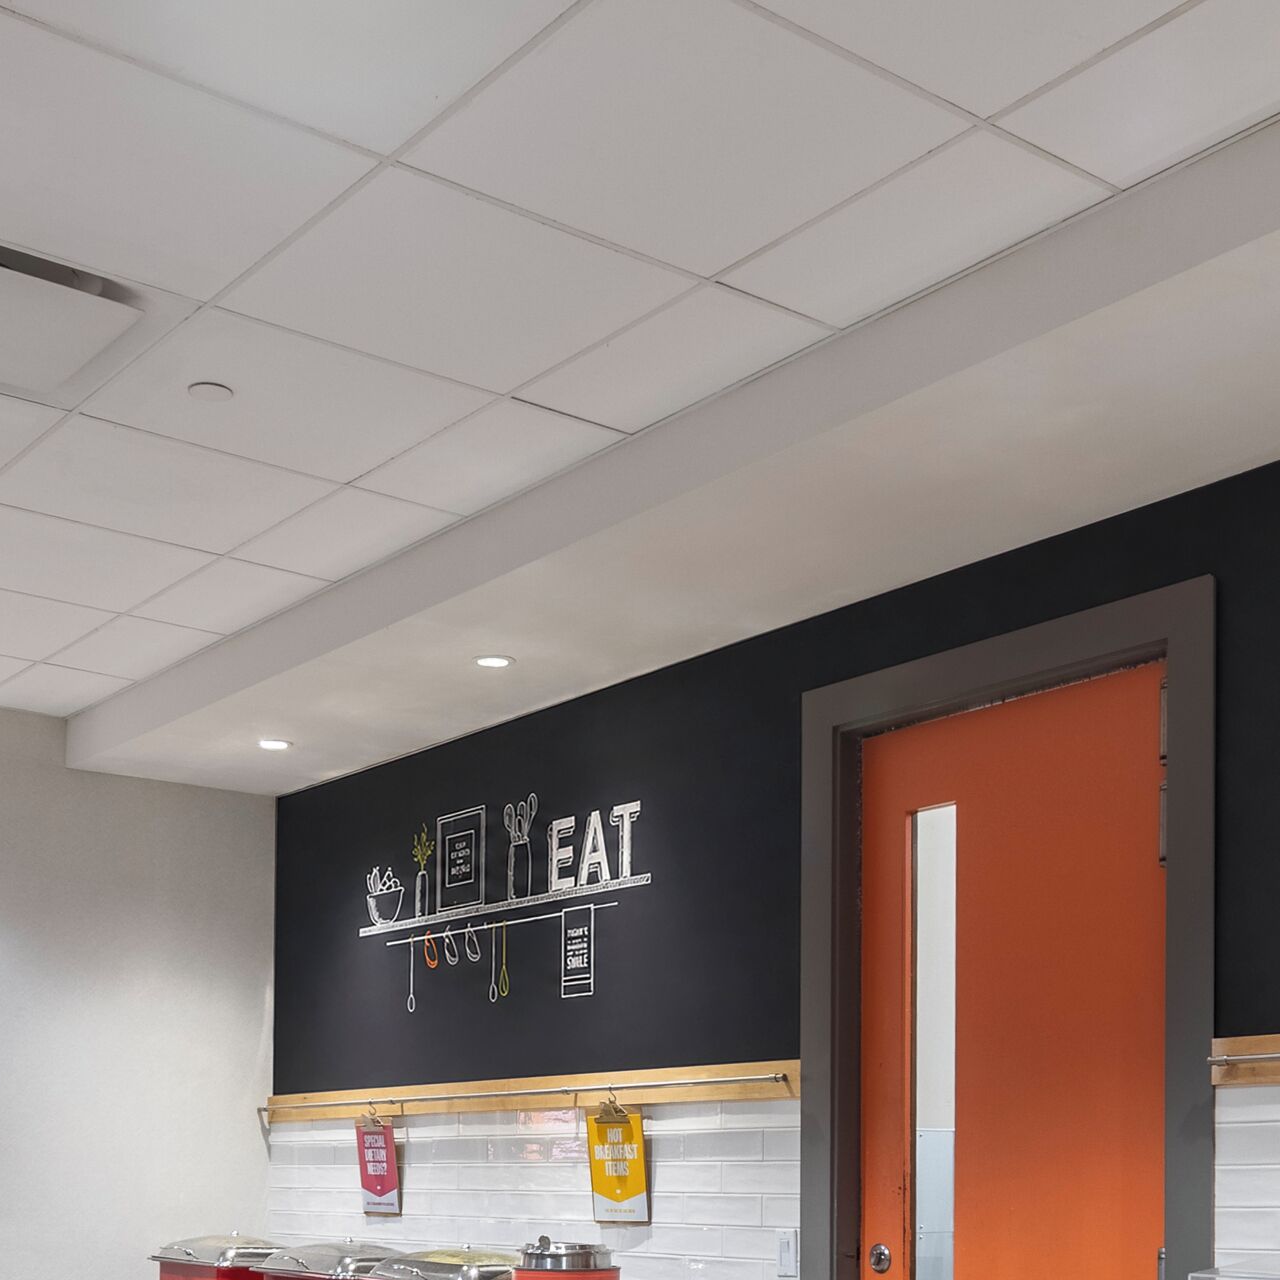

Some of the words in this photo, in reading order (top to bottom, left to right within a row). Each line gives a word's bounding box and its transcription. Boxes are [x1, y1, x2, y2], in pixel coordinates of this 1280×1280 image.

[548, 800, 641, 893] EAT
[364, 1134, 386, 1147] SPECIAL
[607, 1128, 623, 1142] HOT
[594, 1144, 638, 1160] BREAKFAST
[605, 1161, 630, 1177] ITEMS
